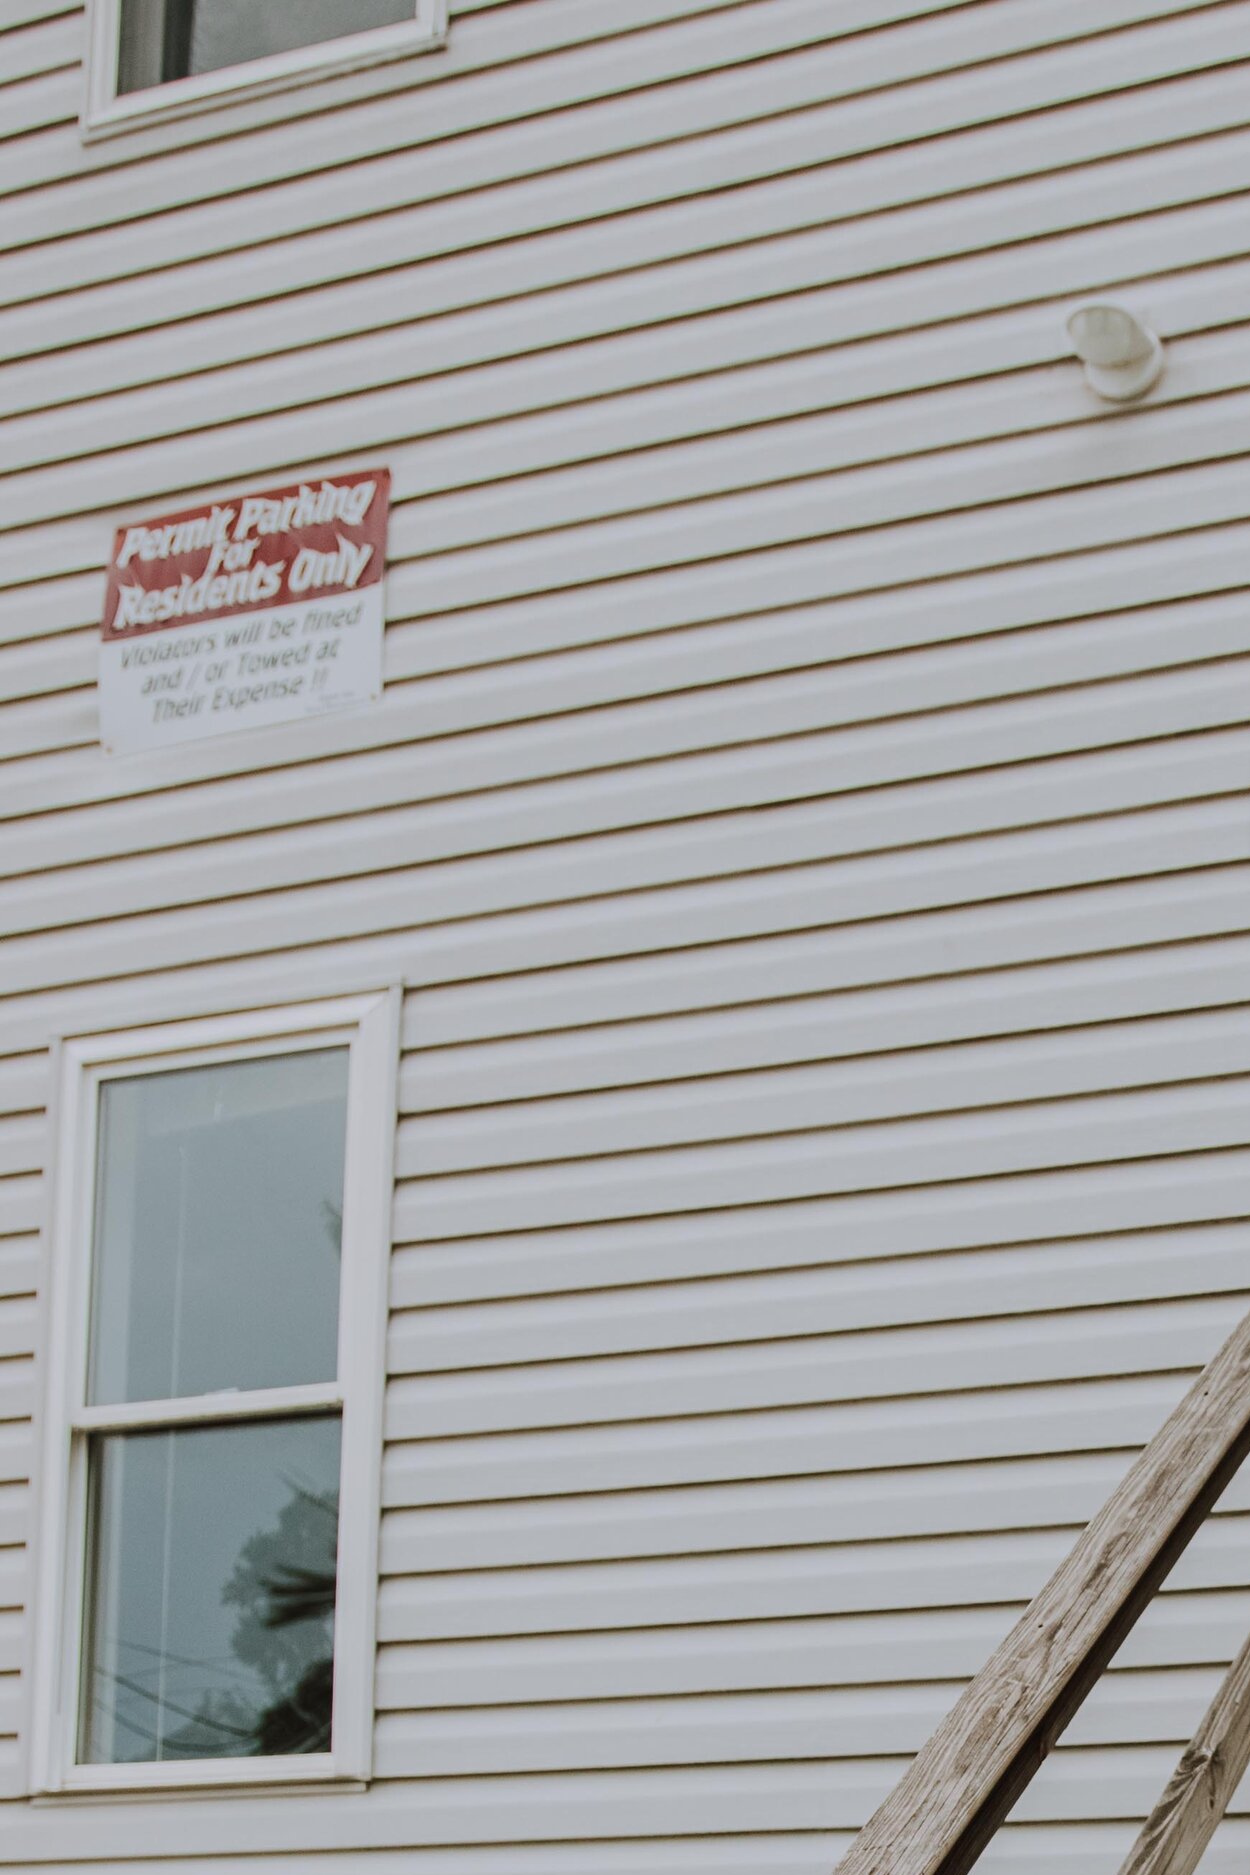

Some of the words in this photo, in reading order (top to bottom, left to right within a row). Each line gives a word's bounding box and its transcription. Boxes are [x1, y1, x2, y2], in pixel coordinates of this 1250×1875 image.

[115, 505, 237, 568] Permit
[233, 480, 377, 540] Parking
[112, 559, 286, 629] Residents
[288, 531, 373, 593] Only
[121, 632, 216, 669] Violators
[224, 621, 264, 648] will
[269, 615, 297, 639] be
[141, 670, 184, 696] and
[204, 658, 229, 683] or
[236, 640, 312, 677] Towed
[315, 637, 342, 660] at
[152, 694, 207, 723] Their
[211, 673, 303, 711] Expense
